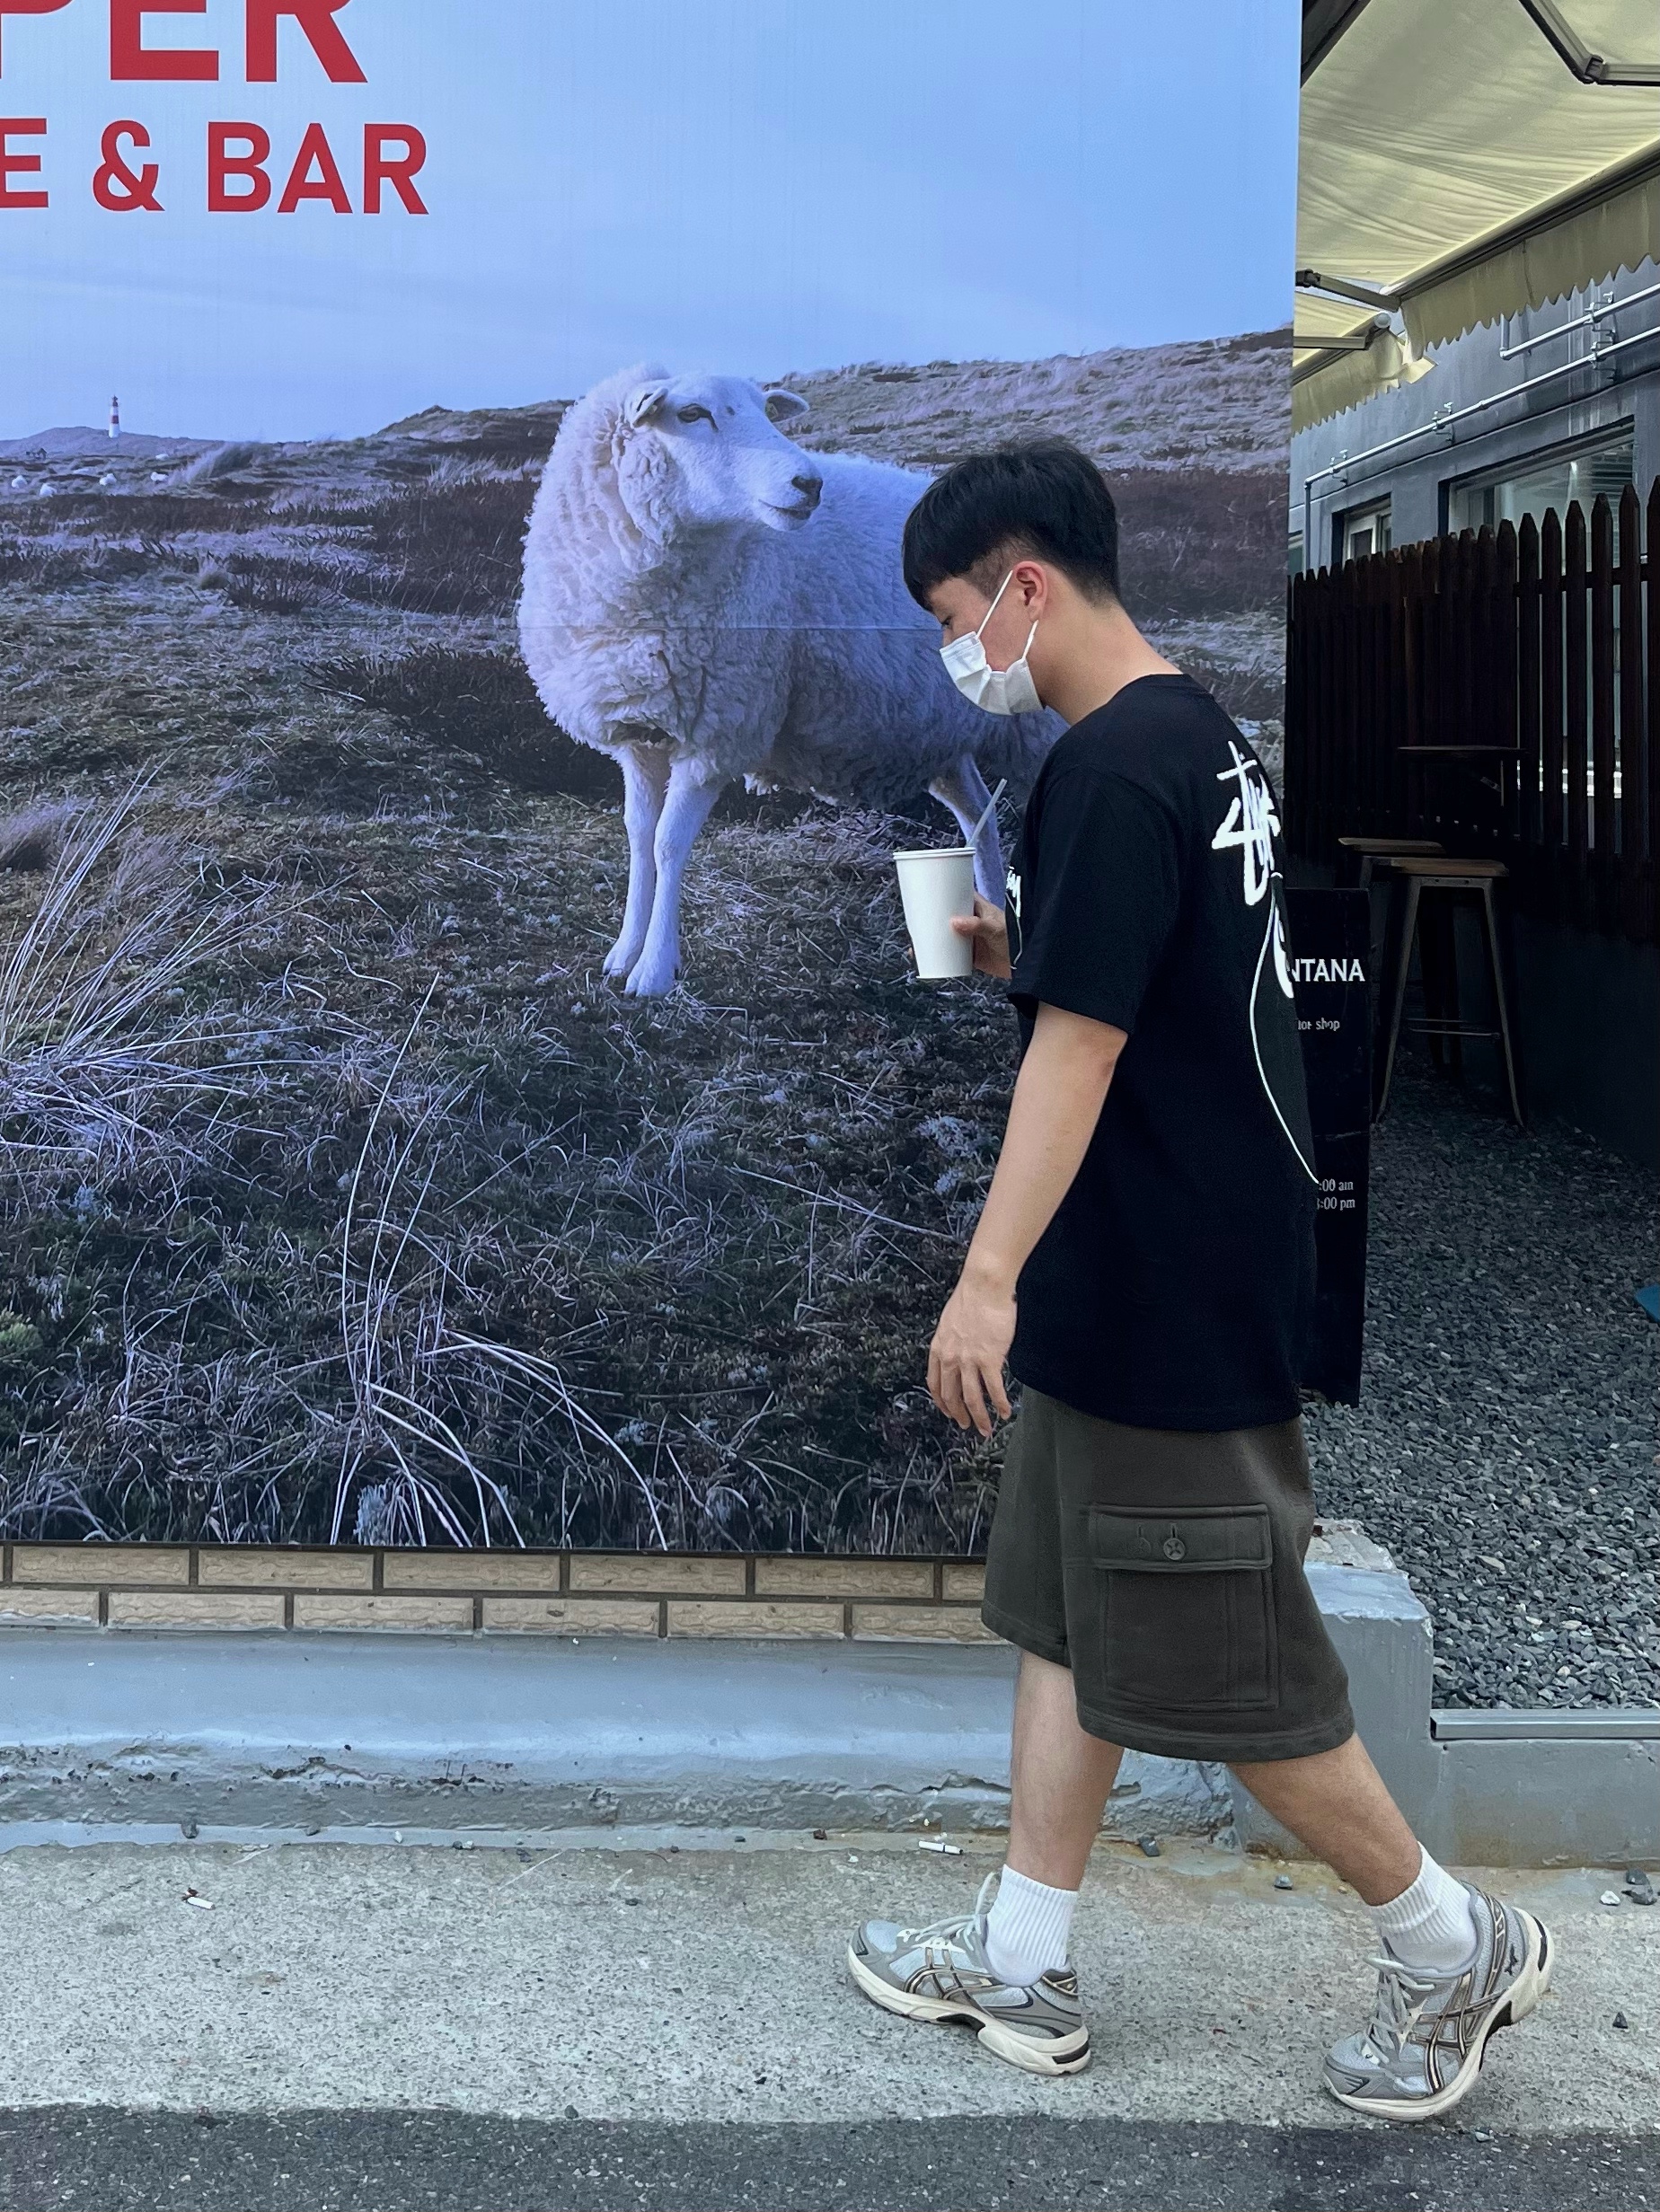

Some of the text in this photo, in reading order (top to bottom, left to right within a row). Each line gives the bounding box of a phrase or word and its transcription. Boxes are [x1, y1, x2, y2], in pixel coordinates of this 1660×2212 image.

[0, 0, 368, 83] ER
[93, 119, 165, 212] &
[208, 121, 429, 215] BAR
[1316, 1017, 1340, 1032] shop
[1338, 1181, 1354, 1191] am
[1339, 1199, 1355, 1211] pm
